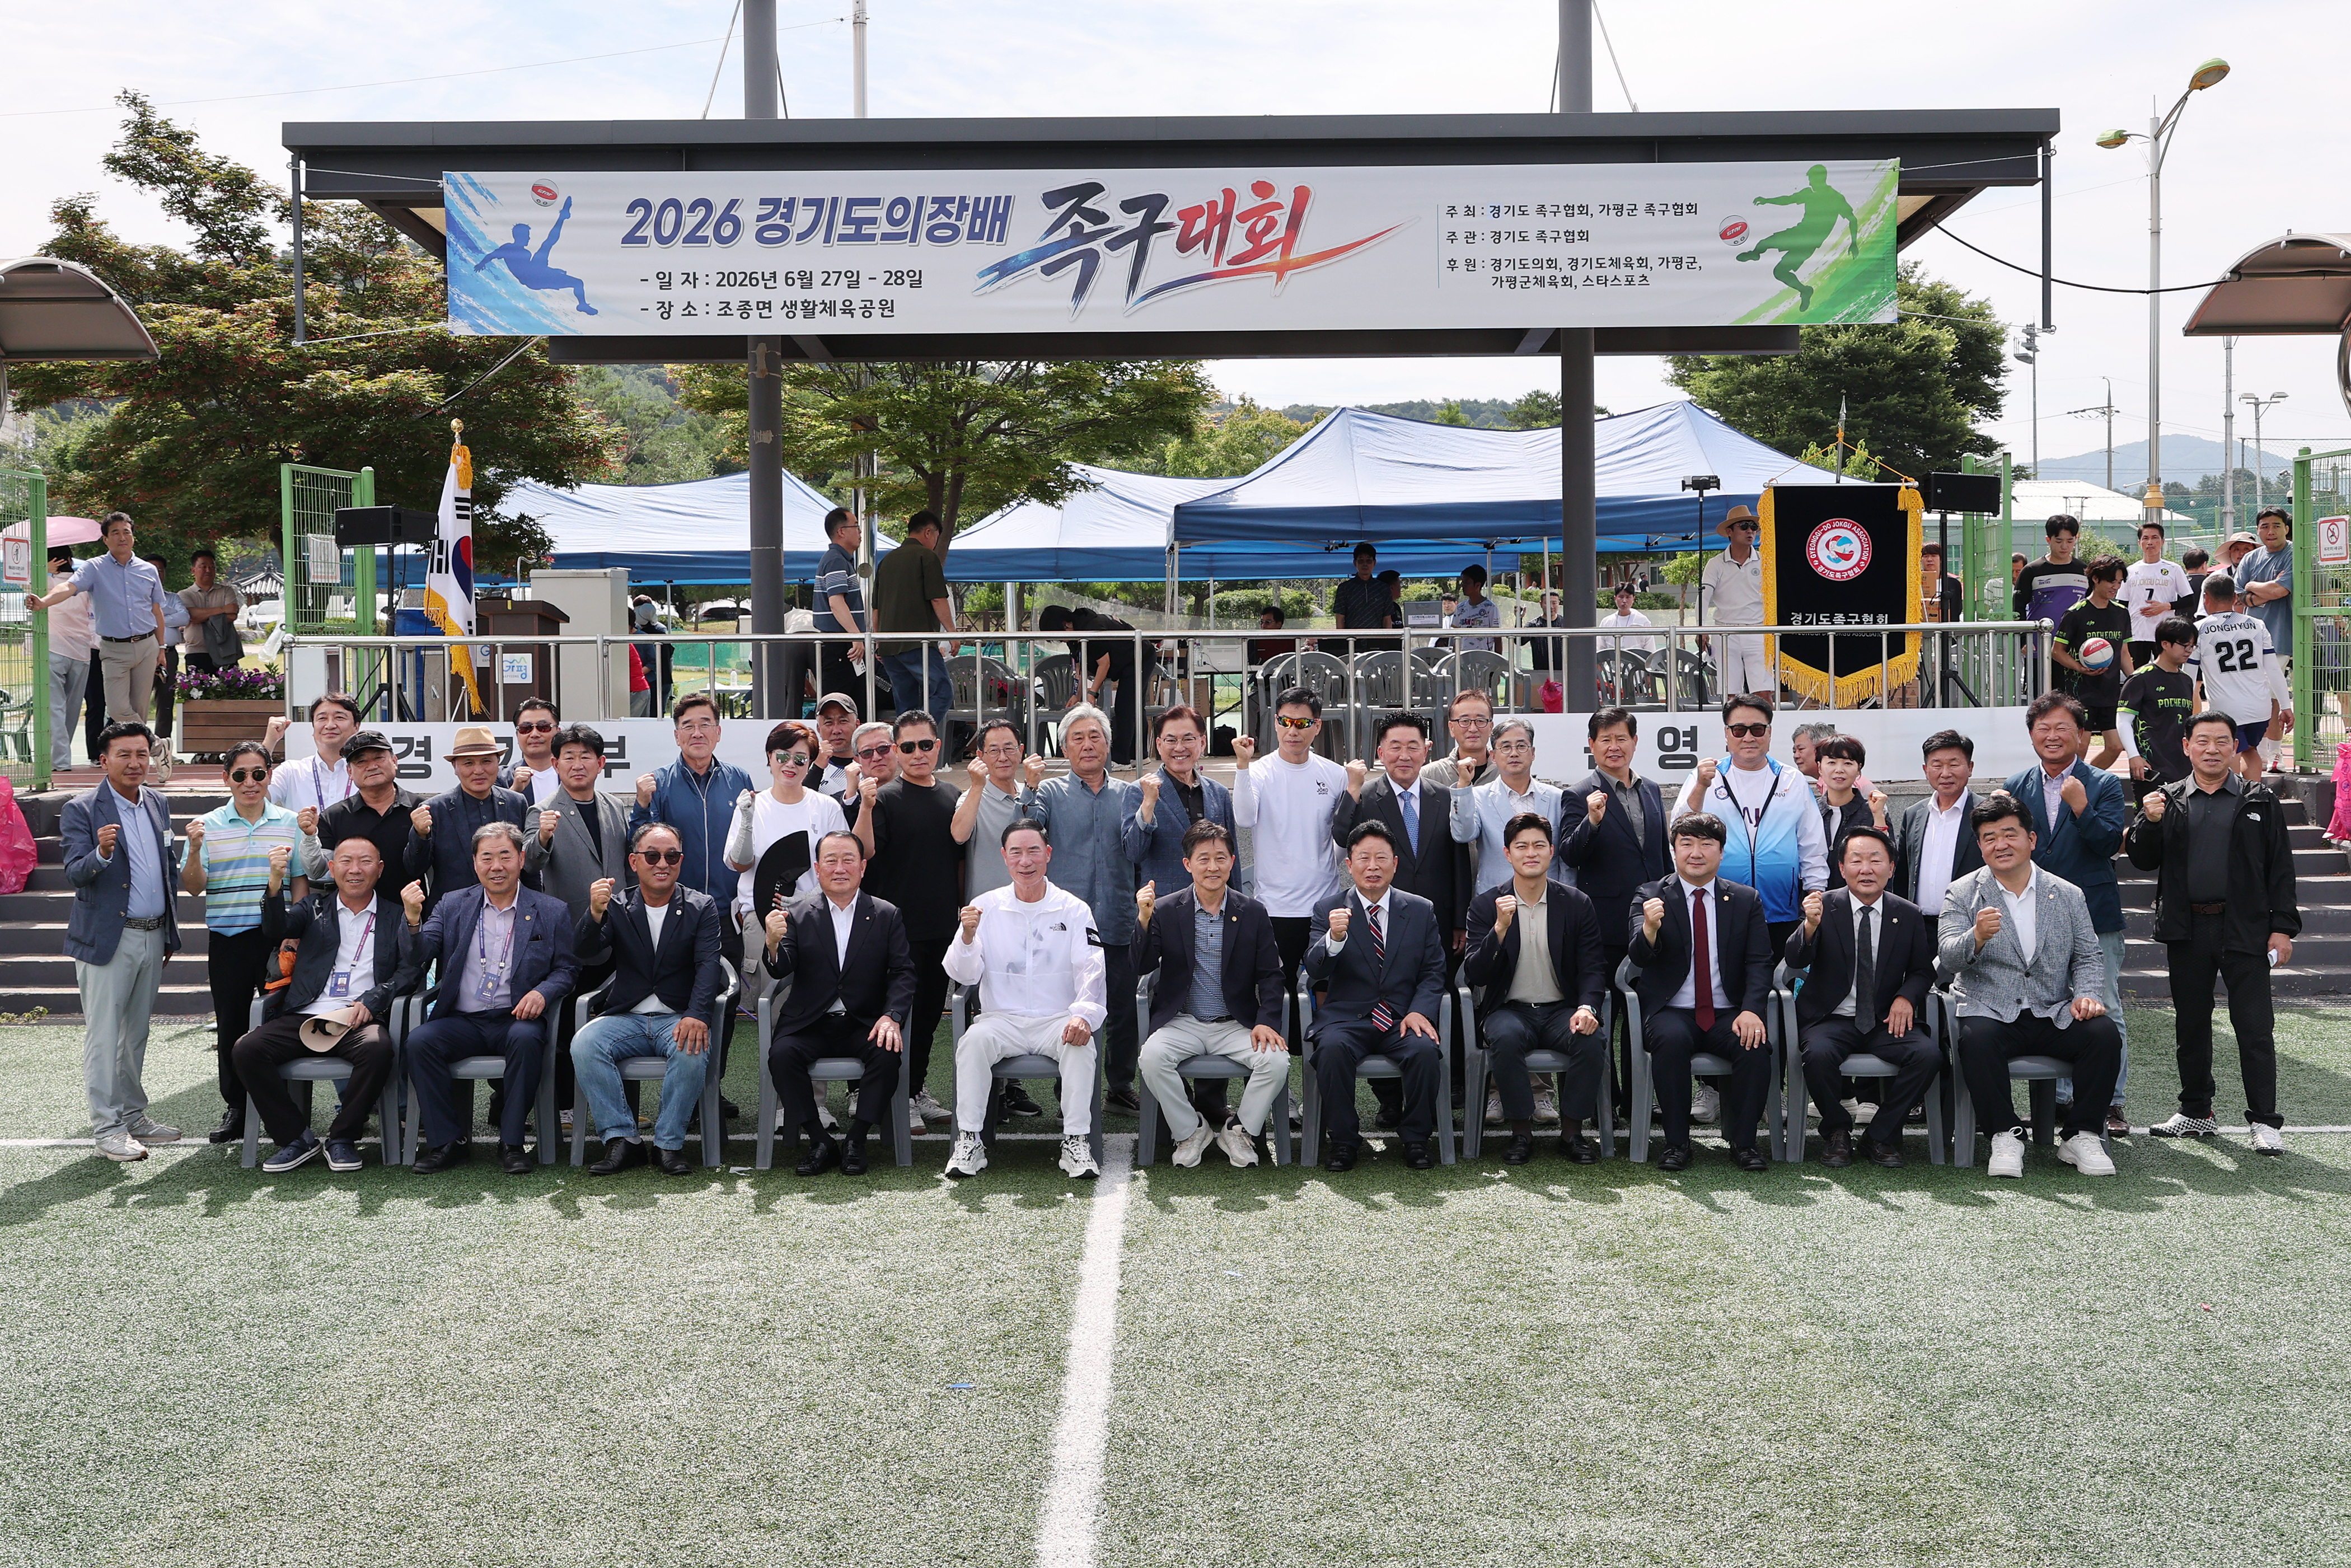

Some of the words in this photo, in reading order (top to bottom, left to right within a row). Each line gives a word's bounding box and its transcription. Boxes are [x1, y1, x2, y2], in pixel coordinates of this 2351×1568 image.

[1446, 205, 1458, 218] 주
[1463, 204, 1476, 218] 최
[1490, 205, 1530, 219] 경기도
[1535, 203, 1593, 218] 족구협회,
[1599, 203, 1638, 217] 가평군
[1644, 202, 1697, 217] 족구협회
[621, 197, 743, 247] 2026
[755, 195, 1014, 247] 경기도의장배
[1446, 231, 1458, 244] 주
[1464, 231, 1477, 244] 관
[1490, 231, 1530, 244] 경기도
[1535, 229, 1589, 244] 족구협회
[977, 177, 1399, 318] 족구대회
[1446, 258, 1459, 272] 후
[1464, 258, 1476, 272] 원
[1491, 257, 1562, 273] 경기도의회,
[1567, 256, 1653, 272] 경기도체육회,
[1658, 256, 1702, 271] 가평군,
[655, 271, 672, 291] 일
[681, 272, 699, 289] 자
[716, 271, 777, 289] 2026년
[785, 270, 813, 289] 6월
[821, 270, 860, 289] 27일
[883, 269, 922, 288] 28일
[1491, 275, 1577, 290] 가평군체육회,
[1582, 274, 1650, 287] 스타스포츠
[656, 301, 674, 320] 장
[681, 301, 698, 316] 소
[717, 300, 772, 320] 조종면
[780, 298, 894, 319] 생활체육공원
[1809, 523, 1832, 559] GYEONGGI-DO
[1832, 521, 1853, 529] JOKGU
[1851, 525, 1870, 561] ASSOCIATION
[1817, 564, 1861, 579] 경기도족구협회
[2155, 578, 2169, 587] CLUB
[2146, 588, 2155, 601] 7
[2204, 622, 2256, 634] JONGHYUN
[2215, 639, 2258, 673] 22
